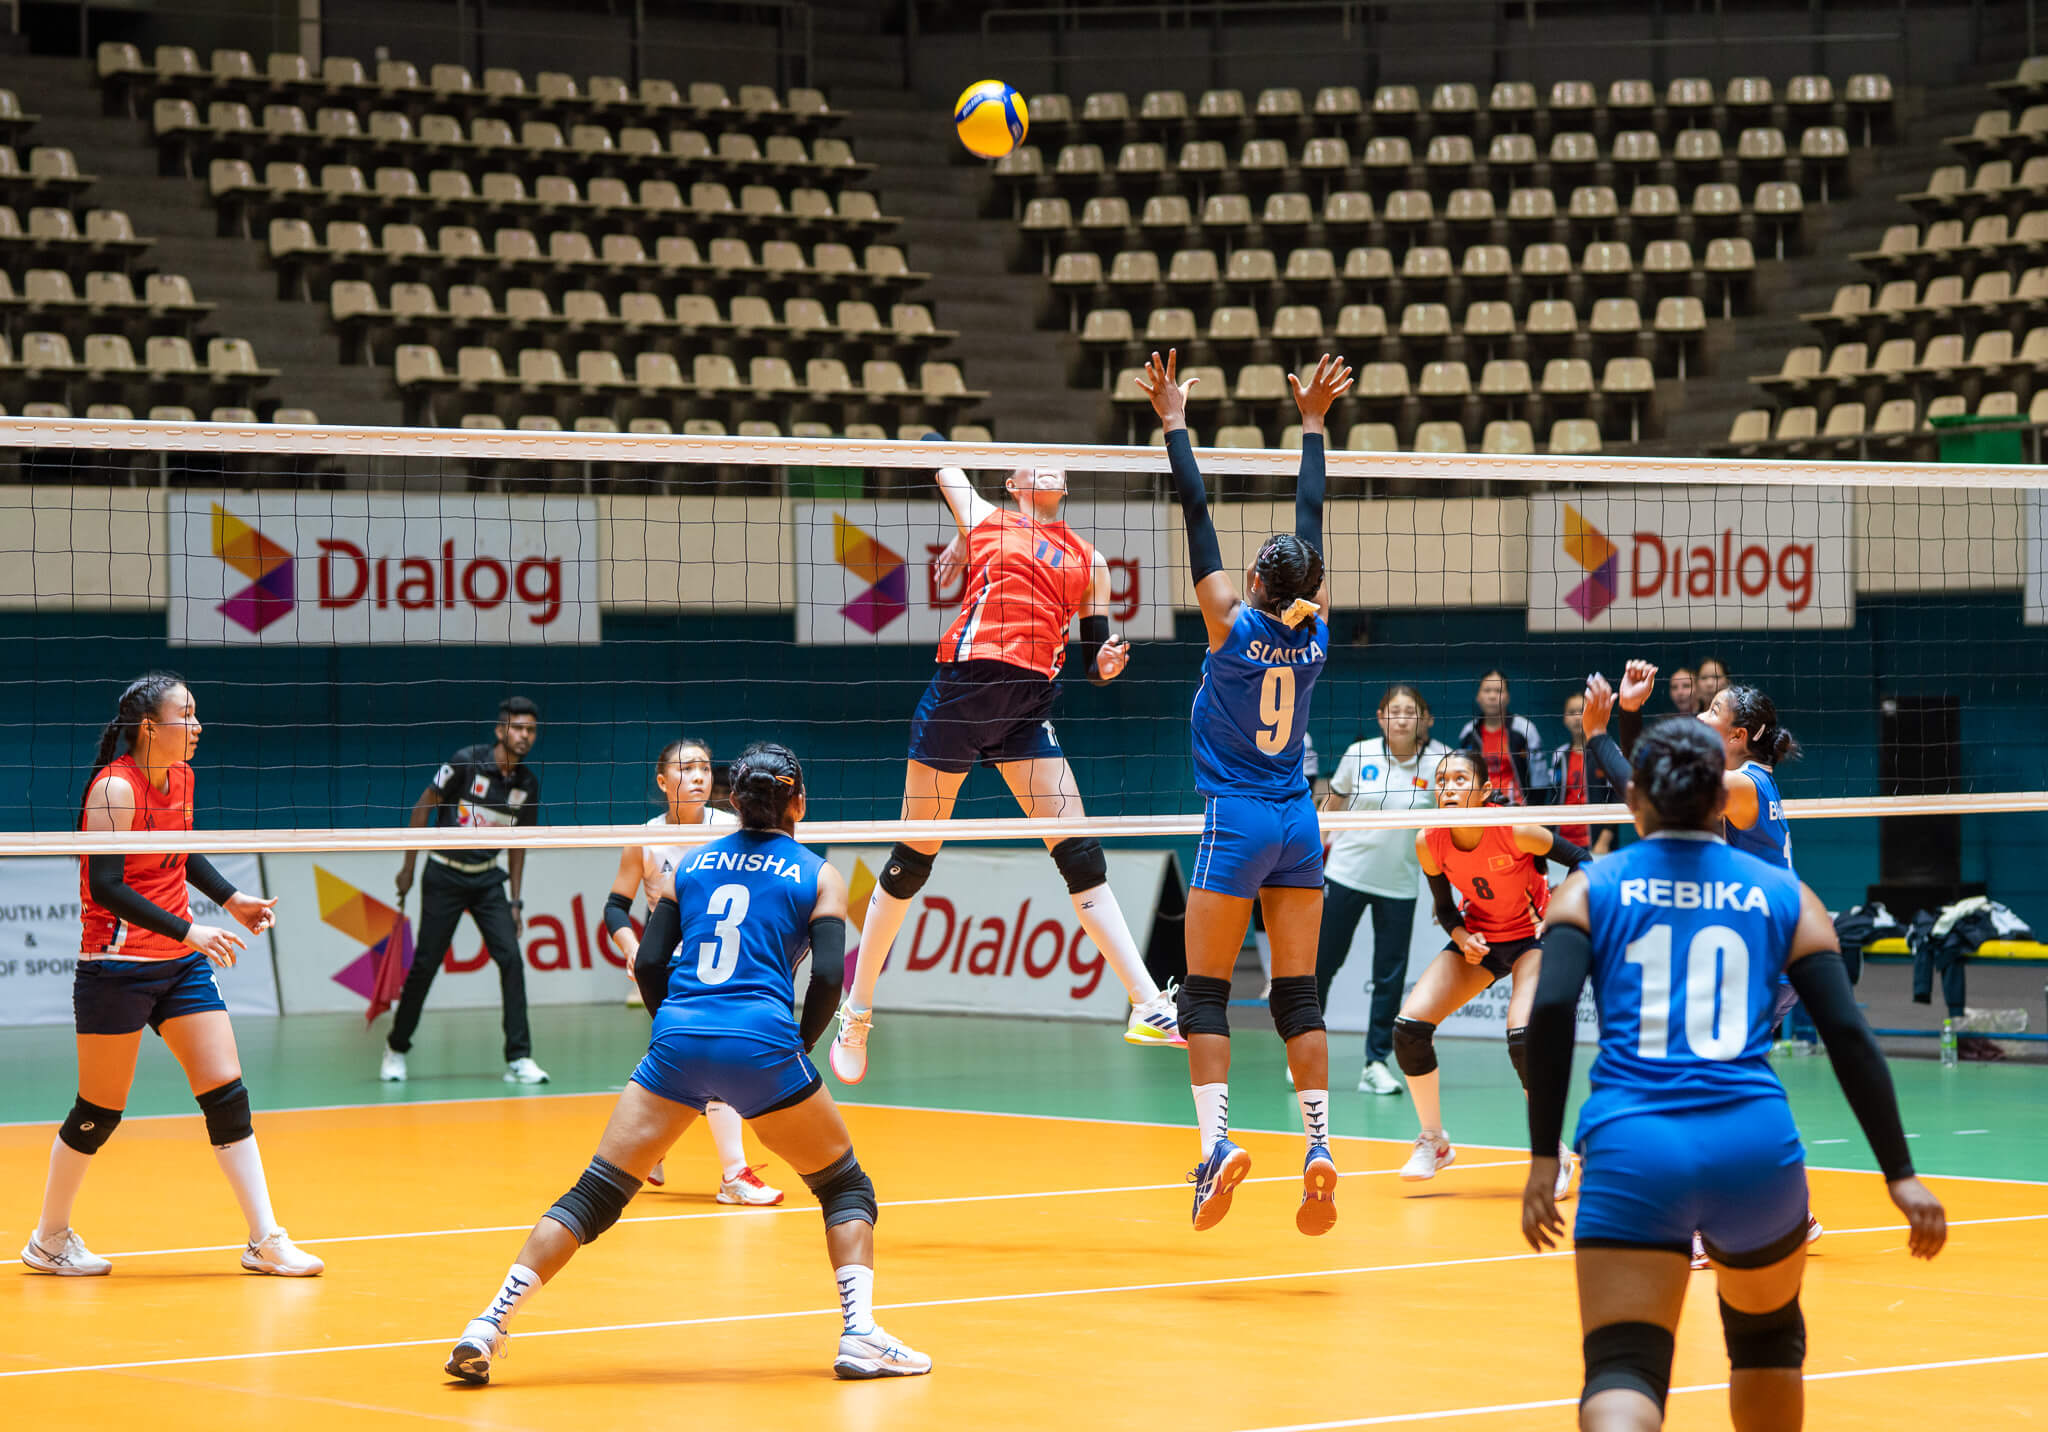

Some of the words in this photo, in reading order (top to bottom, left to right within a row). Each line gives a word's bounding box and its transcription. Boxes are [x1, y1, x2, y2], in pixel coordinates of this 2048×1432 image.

[317, 539, 561, 625] Dialog
[1631, 529, 1814, 612] Dialog
[1247, 640, 1323, 664] SUNITA
[1256, 666, 1295, 756] 9
[686, 851, 800, 883] JENISHA
[1472, 877, 1494, 899] 8
[1620, 878, 1770, 916] REBIKA
[25, 932, 37, 947] &
[697, 884, 749, 985] 3
[906, 896, 1105, 1000] Dialog
[25, 959, 74, 976] SPOR
[1627, 925, 1748, 1060] 10
